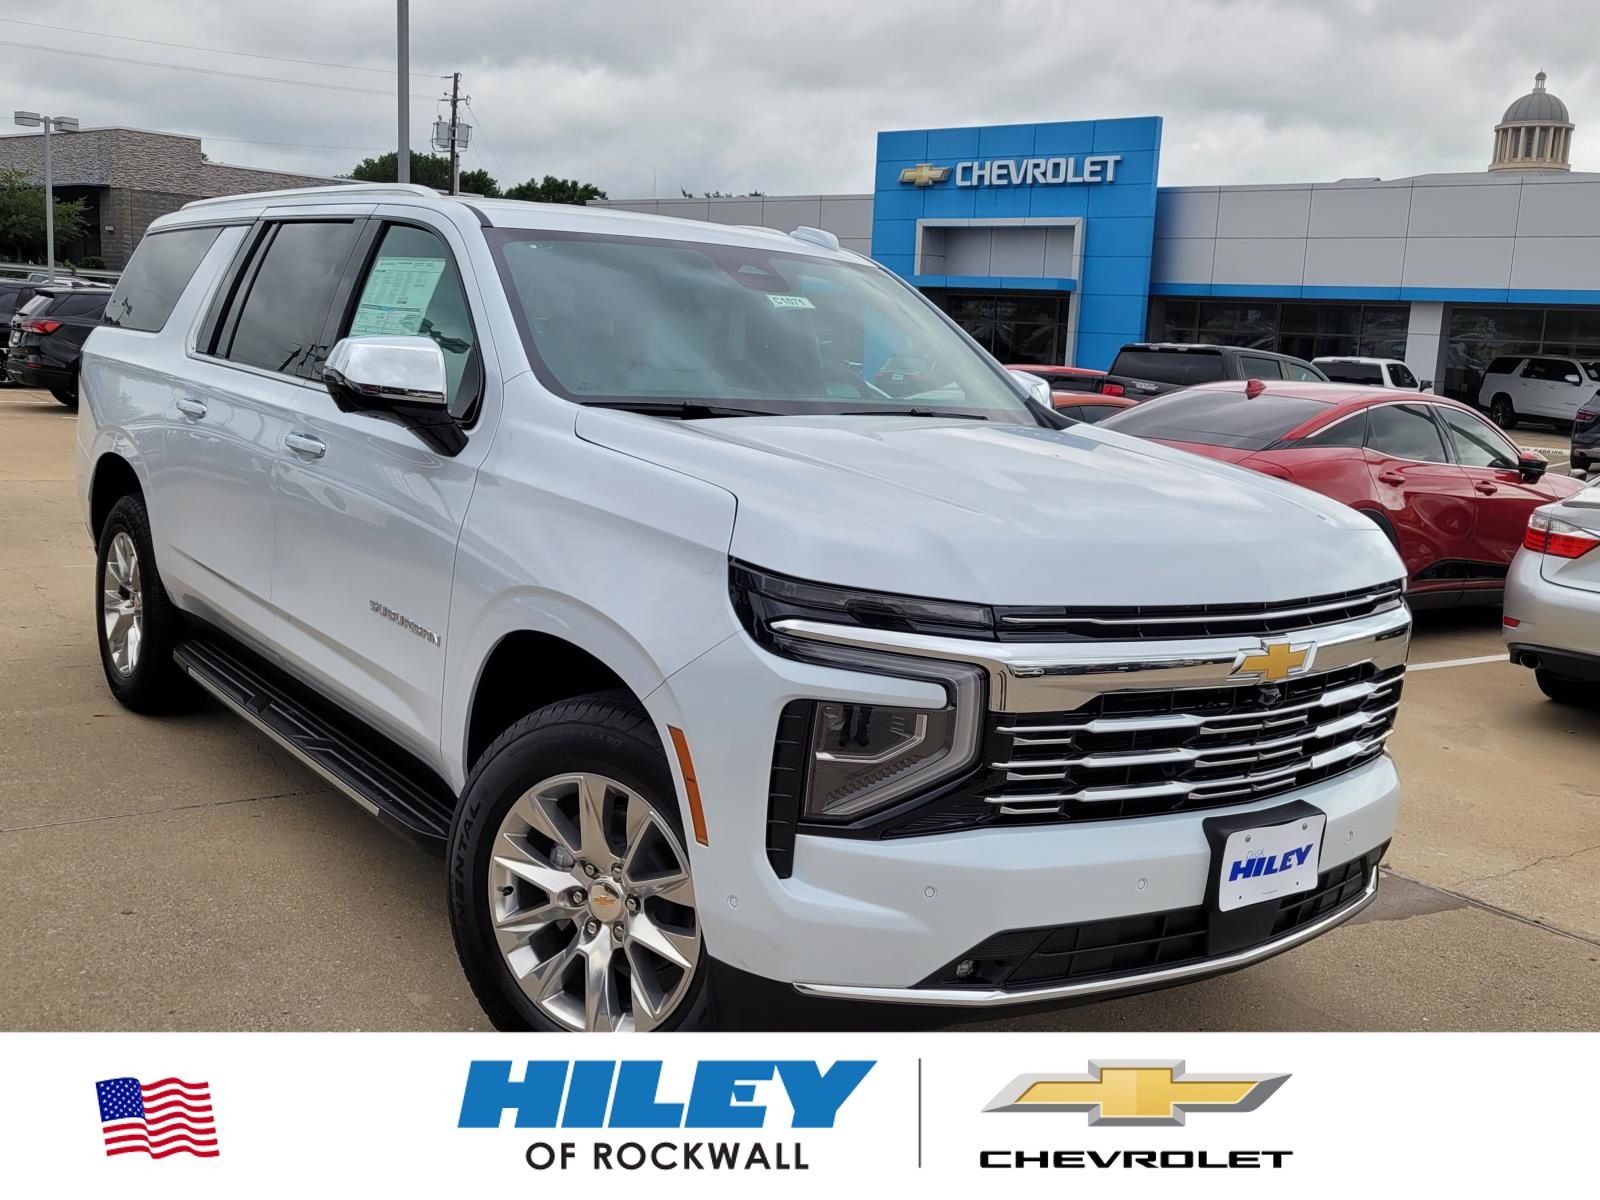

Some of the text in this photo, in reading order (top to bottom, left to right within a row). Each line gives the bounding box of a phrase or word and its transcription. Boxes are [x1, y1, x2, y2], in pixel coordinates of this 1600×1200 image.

[956, 154, 1121, 186] CHEVROLET
[369, 599, 442, 648] SUBURBAN
[1228, 843, 1314, 882] HILEY
